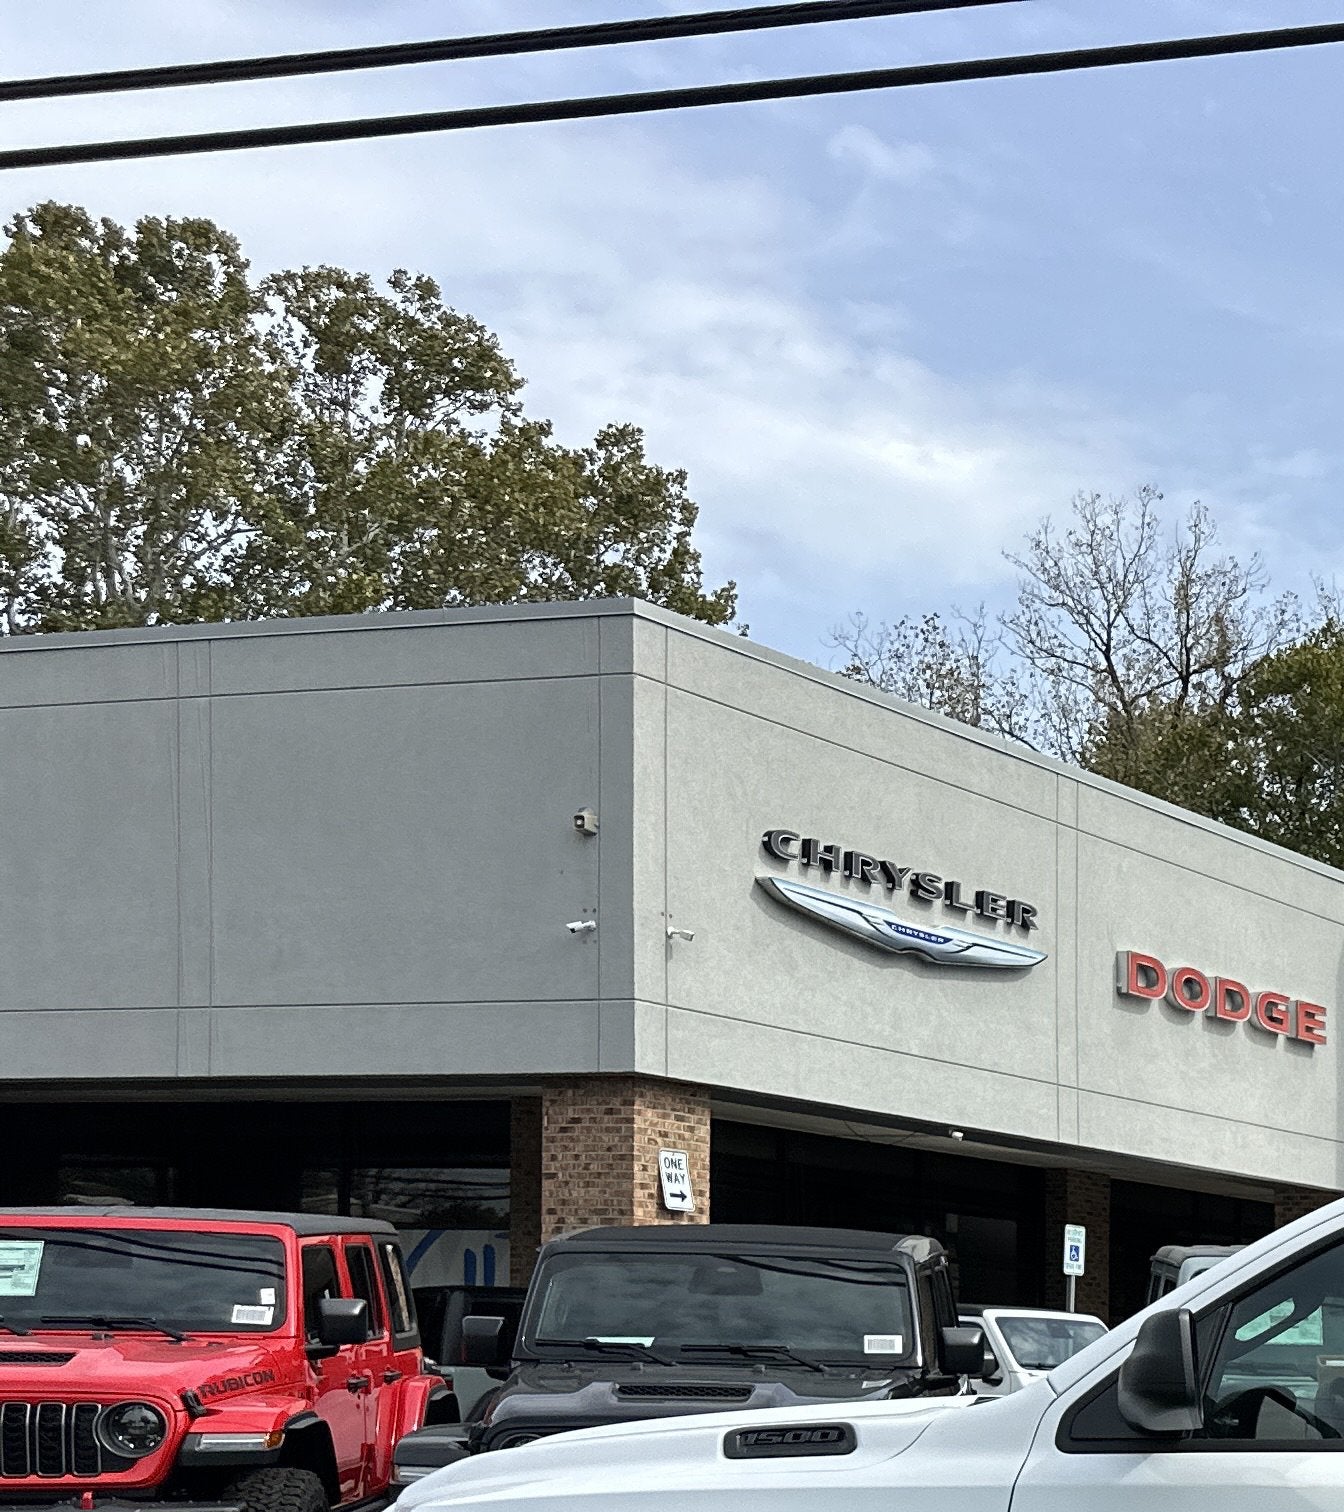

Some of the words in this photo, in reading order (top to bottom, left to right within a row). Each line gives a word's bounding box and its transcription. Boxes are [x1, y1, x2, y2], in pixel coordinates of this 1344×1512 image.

[762, 829, 1039, 930] CHRYSLER
[1117, 950, 1327, 1045] DODGE
[663, 1156, 685, 1171] ONE
[665, 1171, 686, 1185] WAY
[198, 1368, 276, 1400] RUBICON
[742, 1428, 840, 1446] 1500
